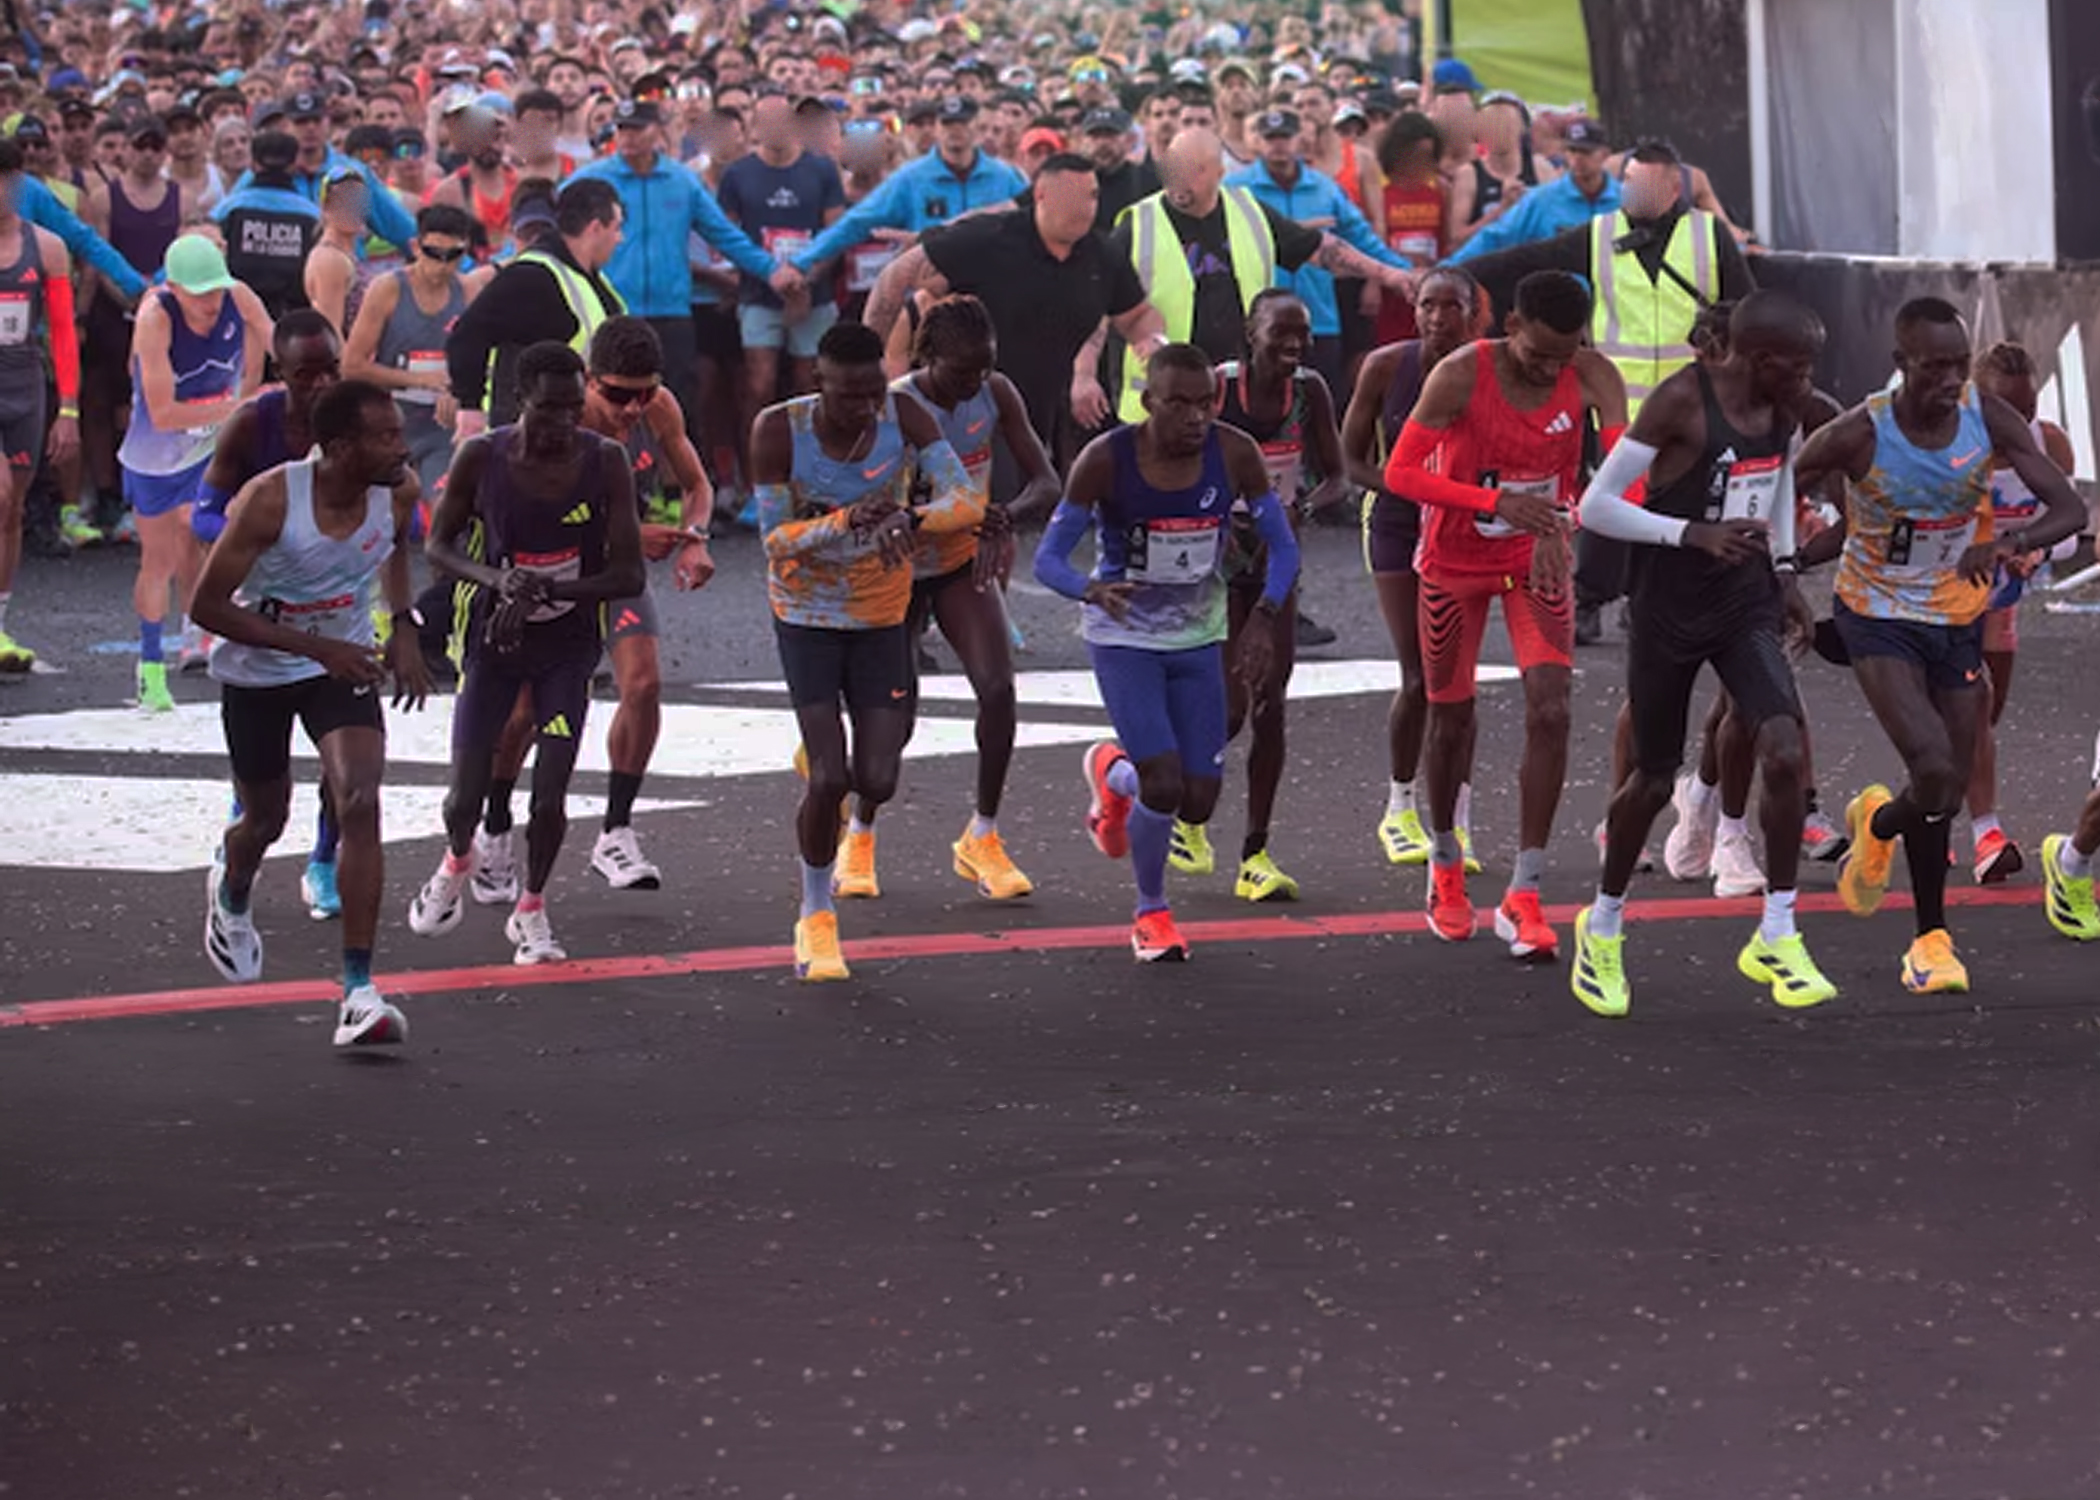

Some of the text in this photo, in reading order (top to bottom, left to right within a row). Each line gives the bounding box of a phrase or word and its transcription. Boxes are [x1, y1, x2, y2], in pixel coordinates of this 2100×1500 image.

[242, 219, 302, 242] POLICIA
[1747, 494, 1759, 517] 6
[854, 531, 871, 548] 12
[1175, 550, 1190, 567] 4
